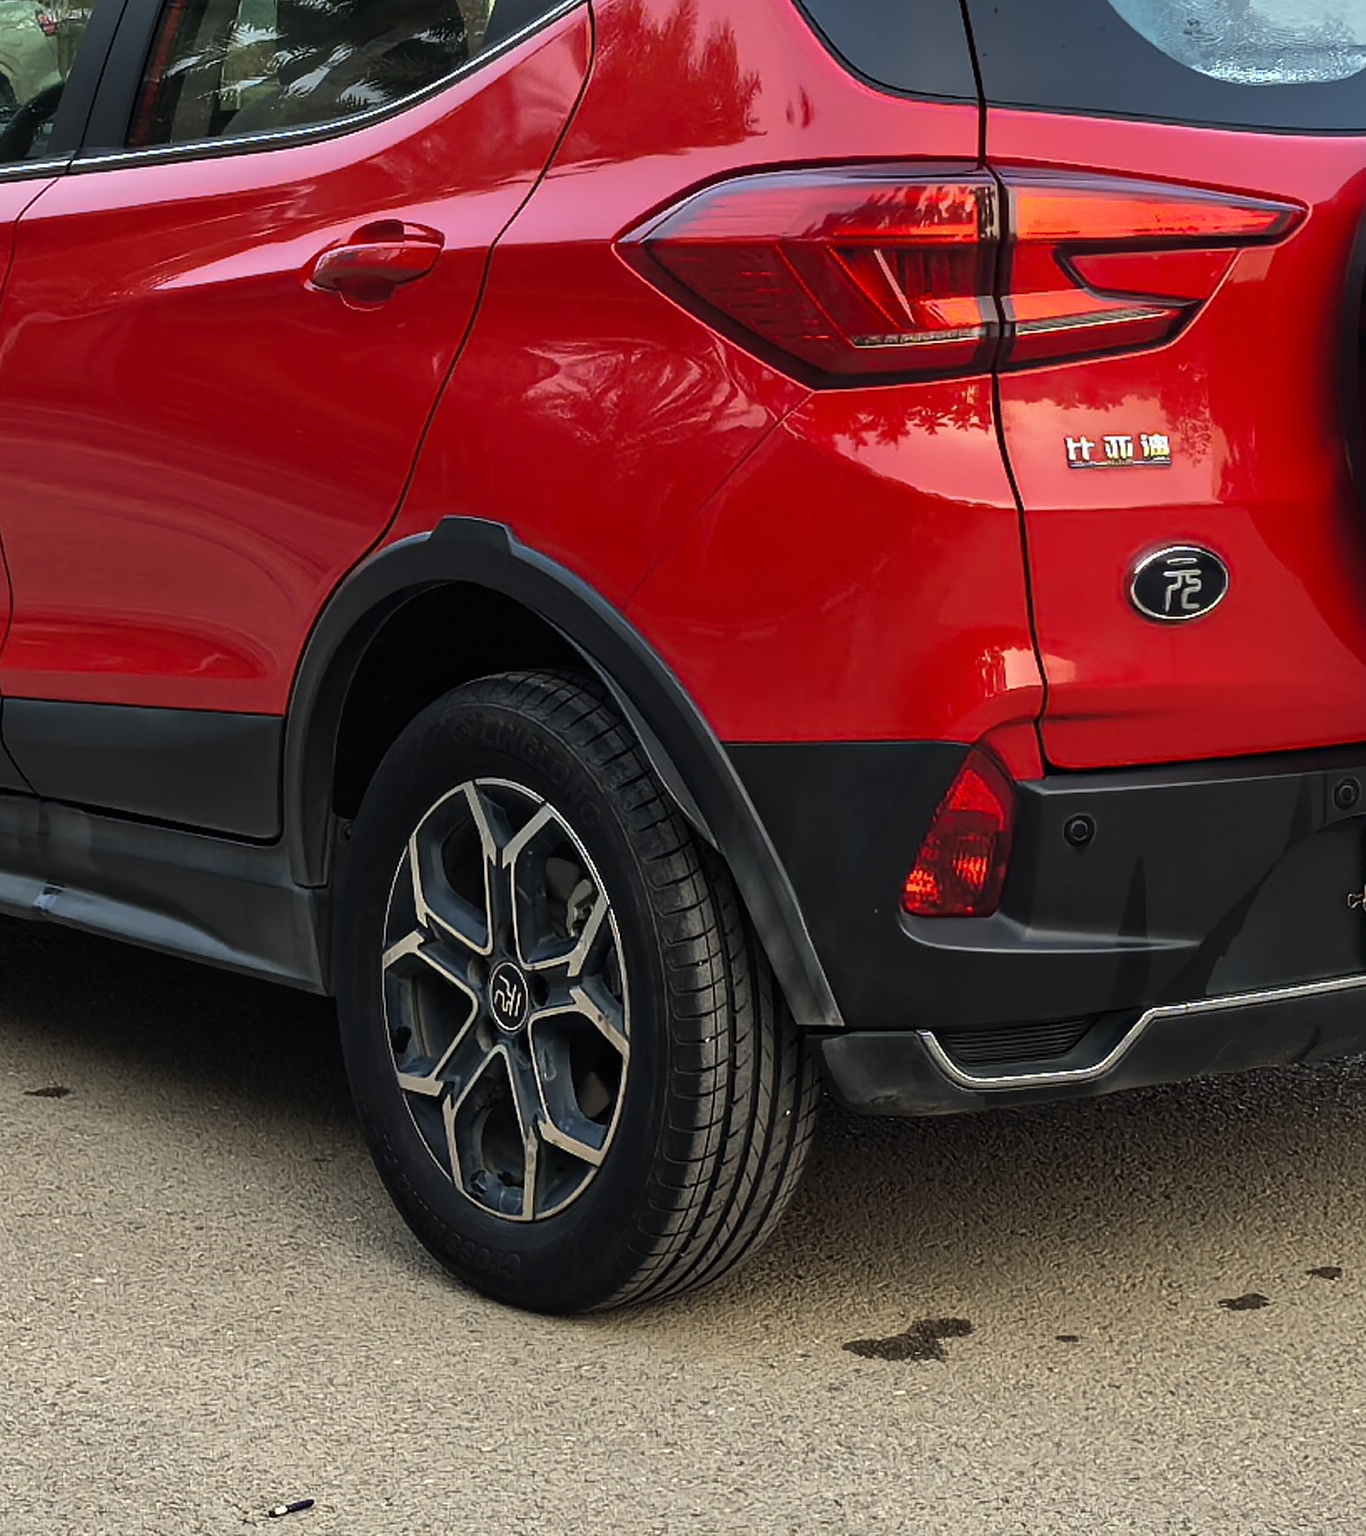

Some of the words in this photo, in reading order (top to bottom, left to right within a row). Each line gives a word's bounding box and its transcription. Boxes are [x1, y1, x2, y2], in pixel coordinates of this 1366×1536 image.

[1065, 434, 1171, 461] 比亚迪
[1162, 557, 1202, 613] 元
